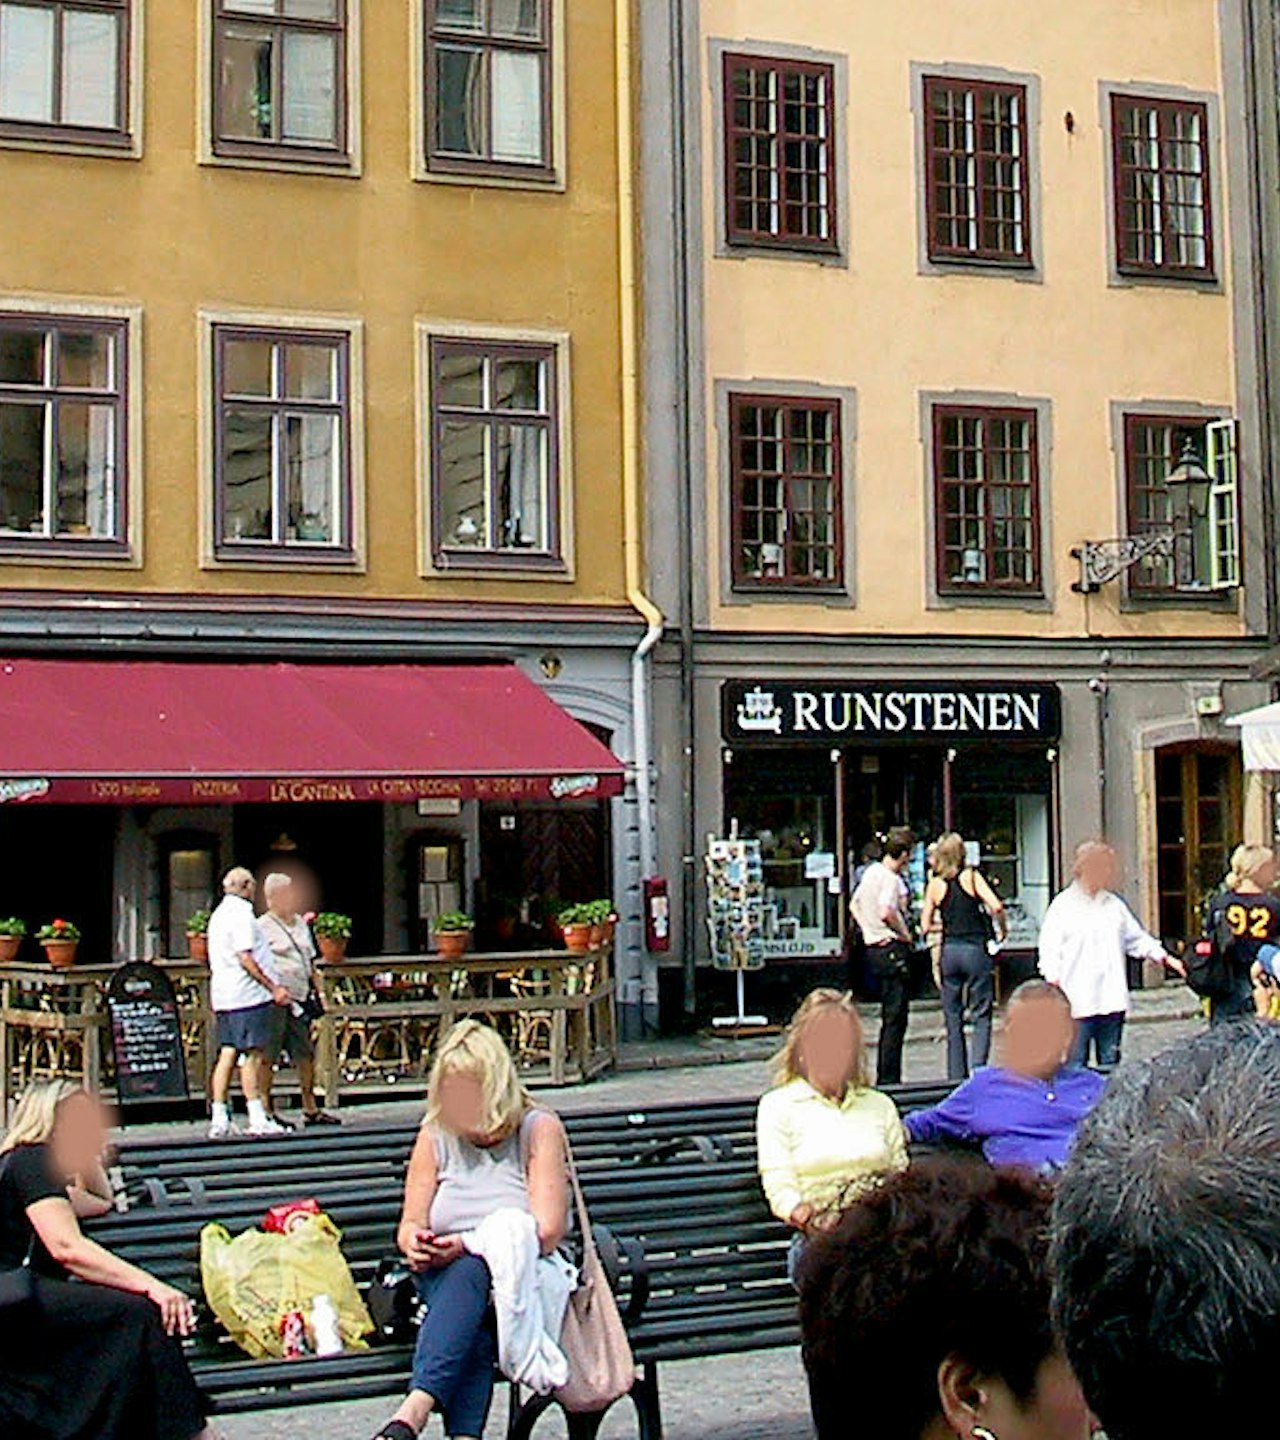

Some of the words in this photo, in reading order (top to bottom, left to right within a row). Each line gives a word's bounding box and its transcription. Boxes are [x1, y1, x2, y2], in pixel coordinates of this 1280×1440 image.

[792, 691, 1041, 732] RUNSTENEN
[192, 779, 241, 797] PIZZERIA
[270, 783, 289, 802] LA
[289, 782, 356, 802] CANTINA
[1226, 904, 1271, 939] 92
